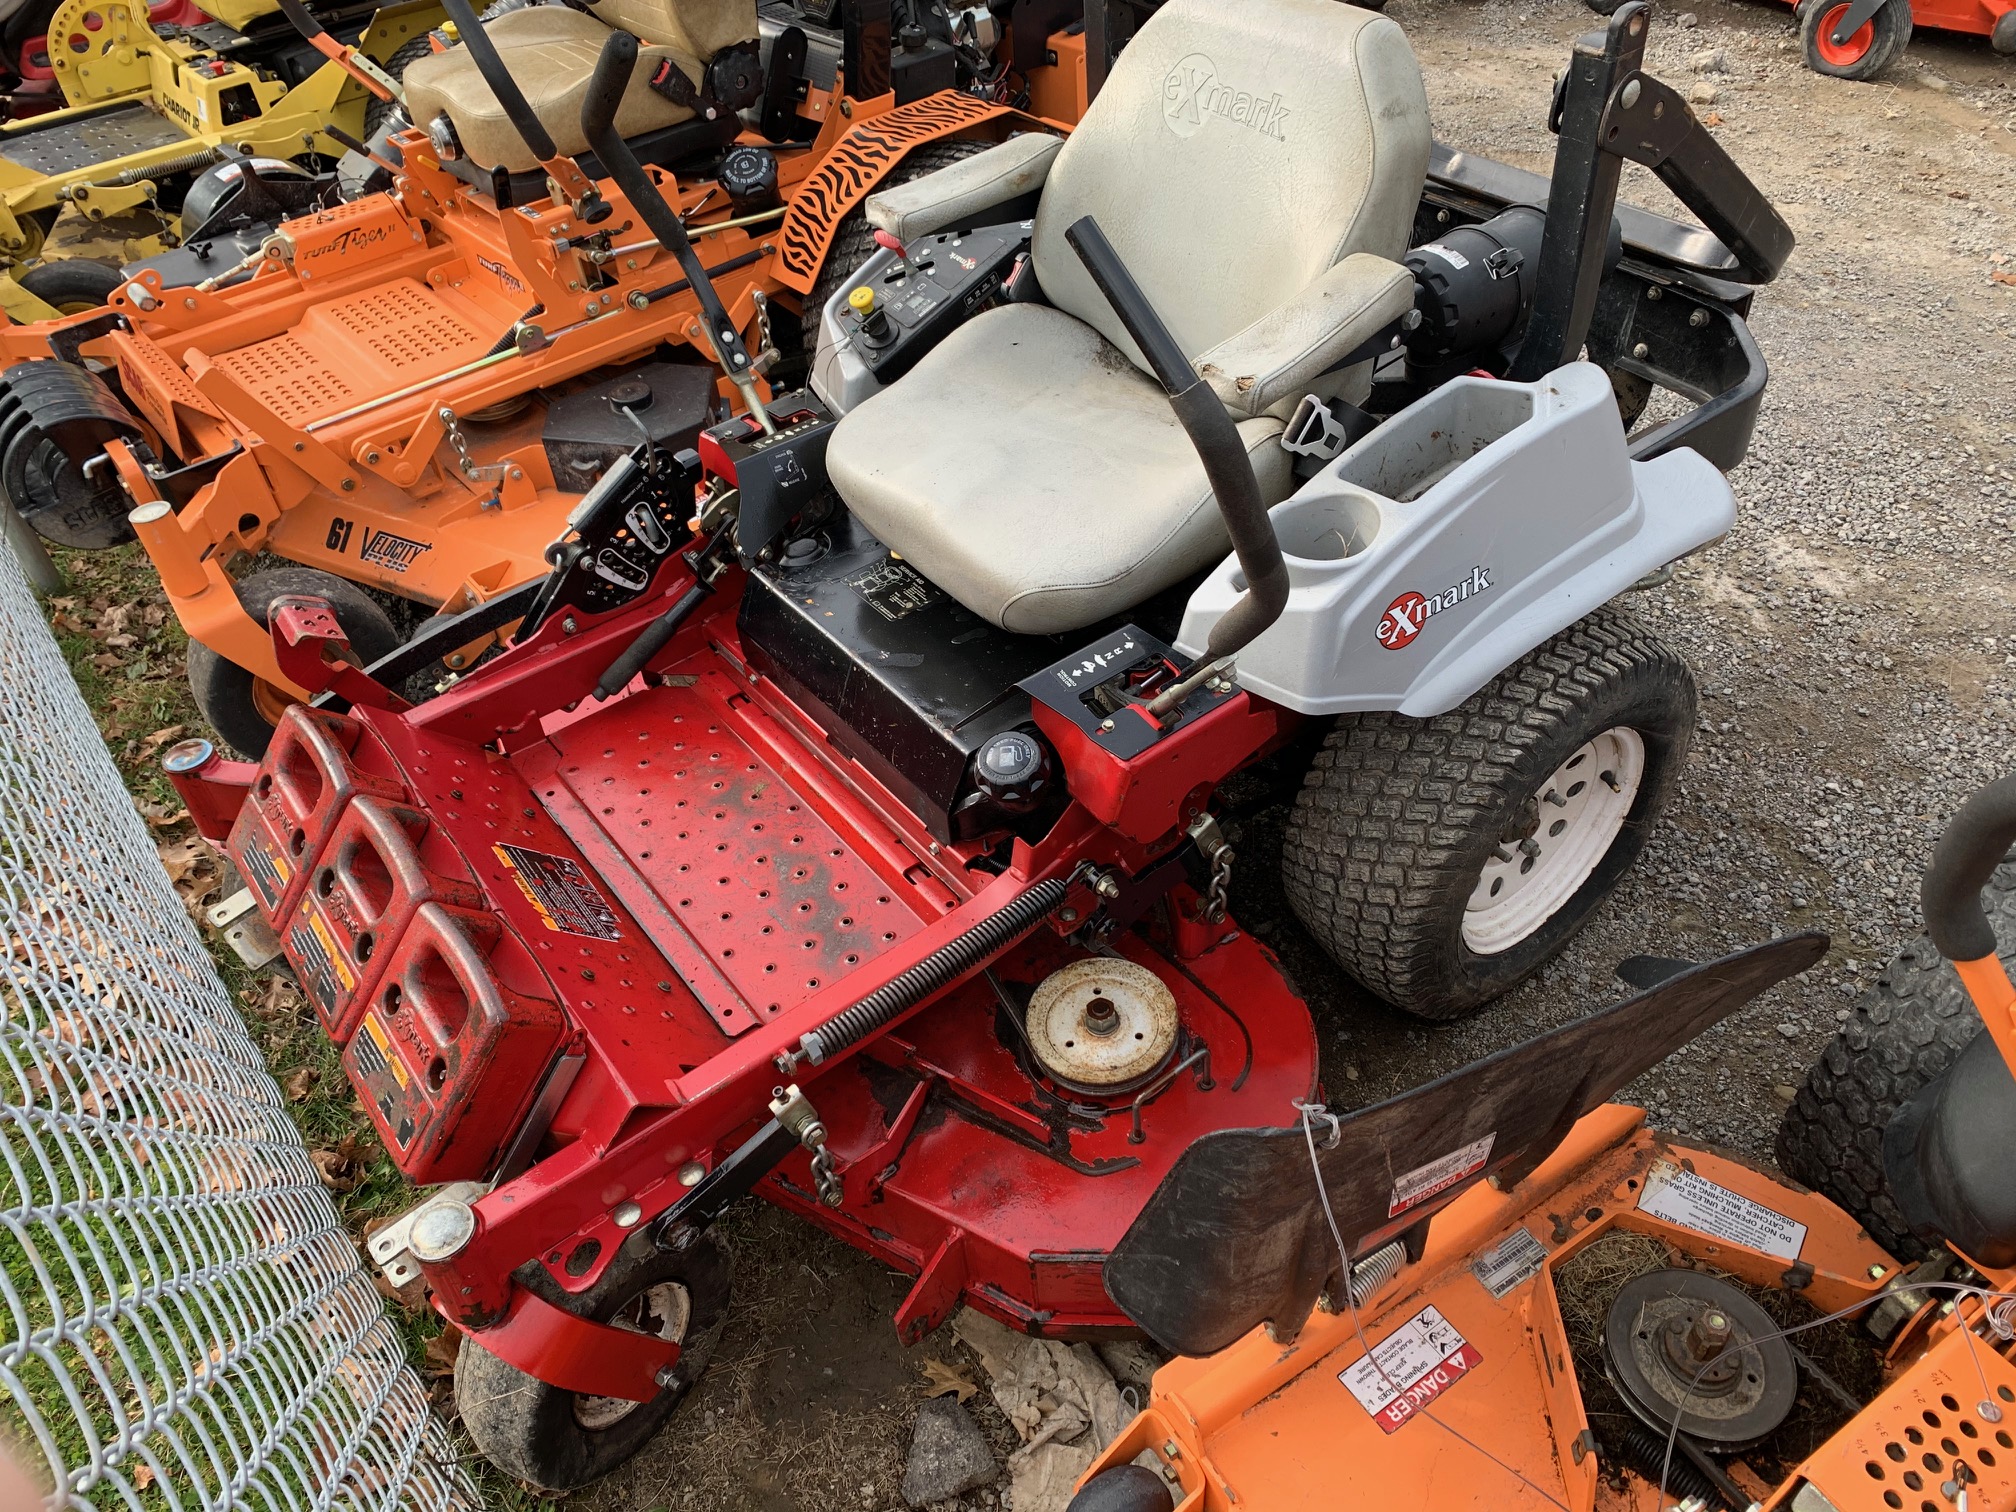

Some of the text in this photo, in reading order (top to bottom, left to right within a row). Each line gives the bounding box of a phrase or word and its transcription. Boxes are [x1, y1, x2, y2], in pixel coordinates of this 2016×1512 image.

[162, 92, 190, 126] CHARIOT
[326, 517, 354, 553] 61
[360, 526, 430, 564] VELOCITY
[1375, 566, 1490, 646] eXmark
[1104, 652, 1115, 660] N
[1114, 647, 1124, 655] R
[1056, 672, 1072, 687] MOTION
[1060, 669, 1077, 687] CONTROL
[1406, 1176, 1457, 1207] DANGER
[1684, 1182, 1697, 1190] KIT
[1720, 1188, 1746, 1205] CHUTE
[1660, 1176, 1792, 1243] DO NOT OPERATE UNLESS GRASS
[1699, 1186, 1742, 1211] MULCHING
[1748, 1202, 1795, 1228] DISCHARGE
[1383, 1338, 1403, 1355] OBJECTS
[1399, 1338, 1414, 1352] BLADE
[1380, 1350, 1400, 1367] CONTACT
[1356, 1368, 1376, 1385] THROWN
[1378, 1360, 1428, 1402] SPINNING BADES
[1380, 1360, 1407, 1383] KEEP CLER
[1386, 1368, 1450, 1422] DANGER
